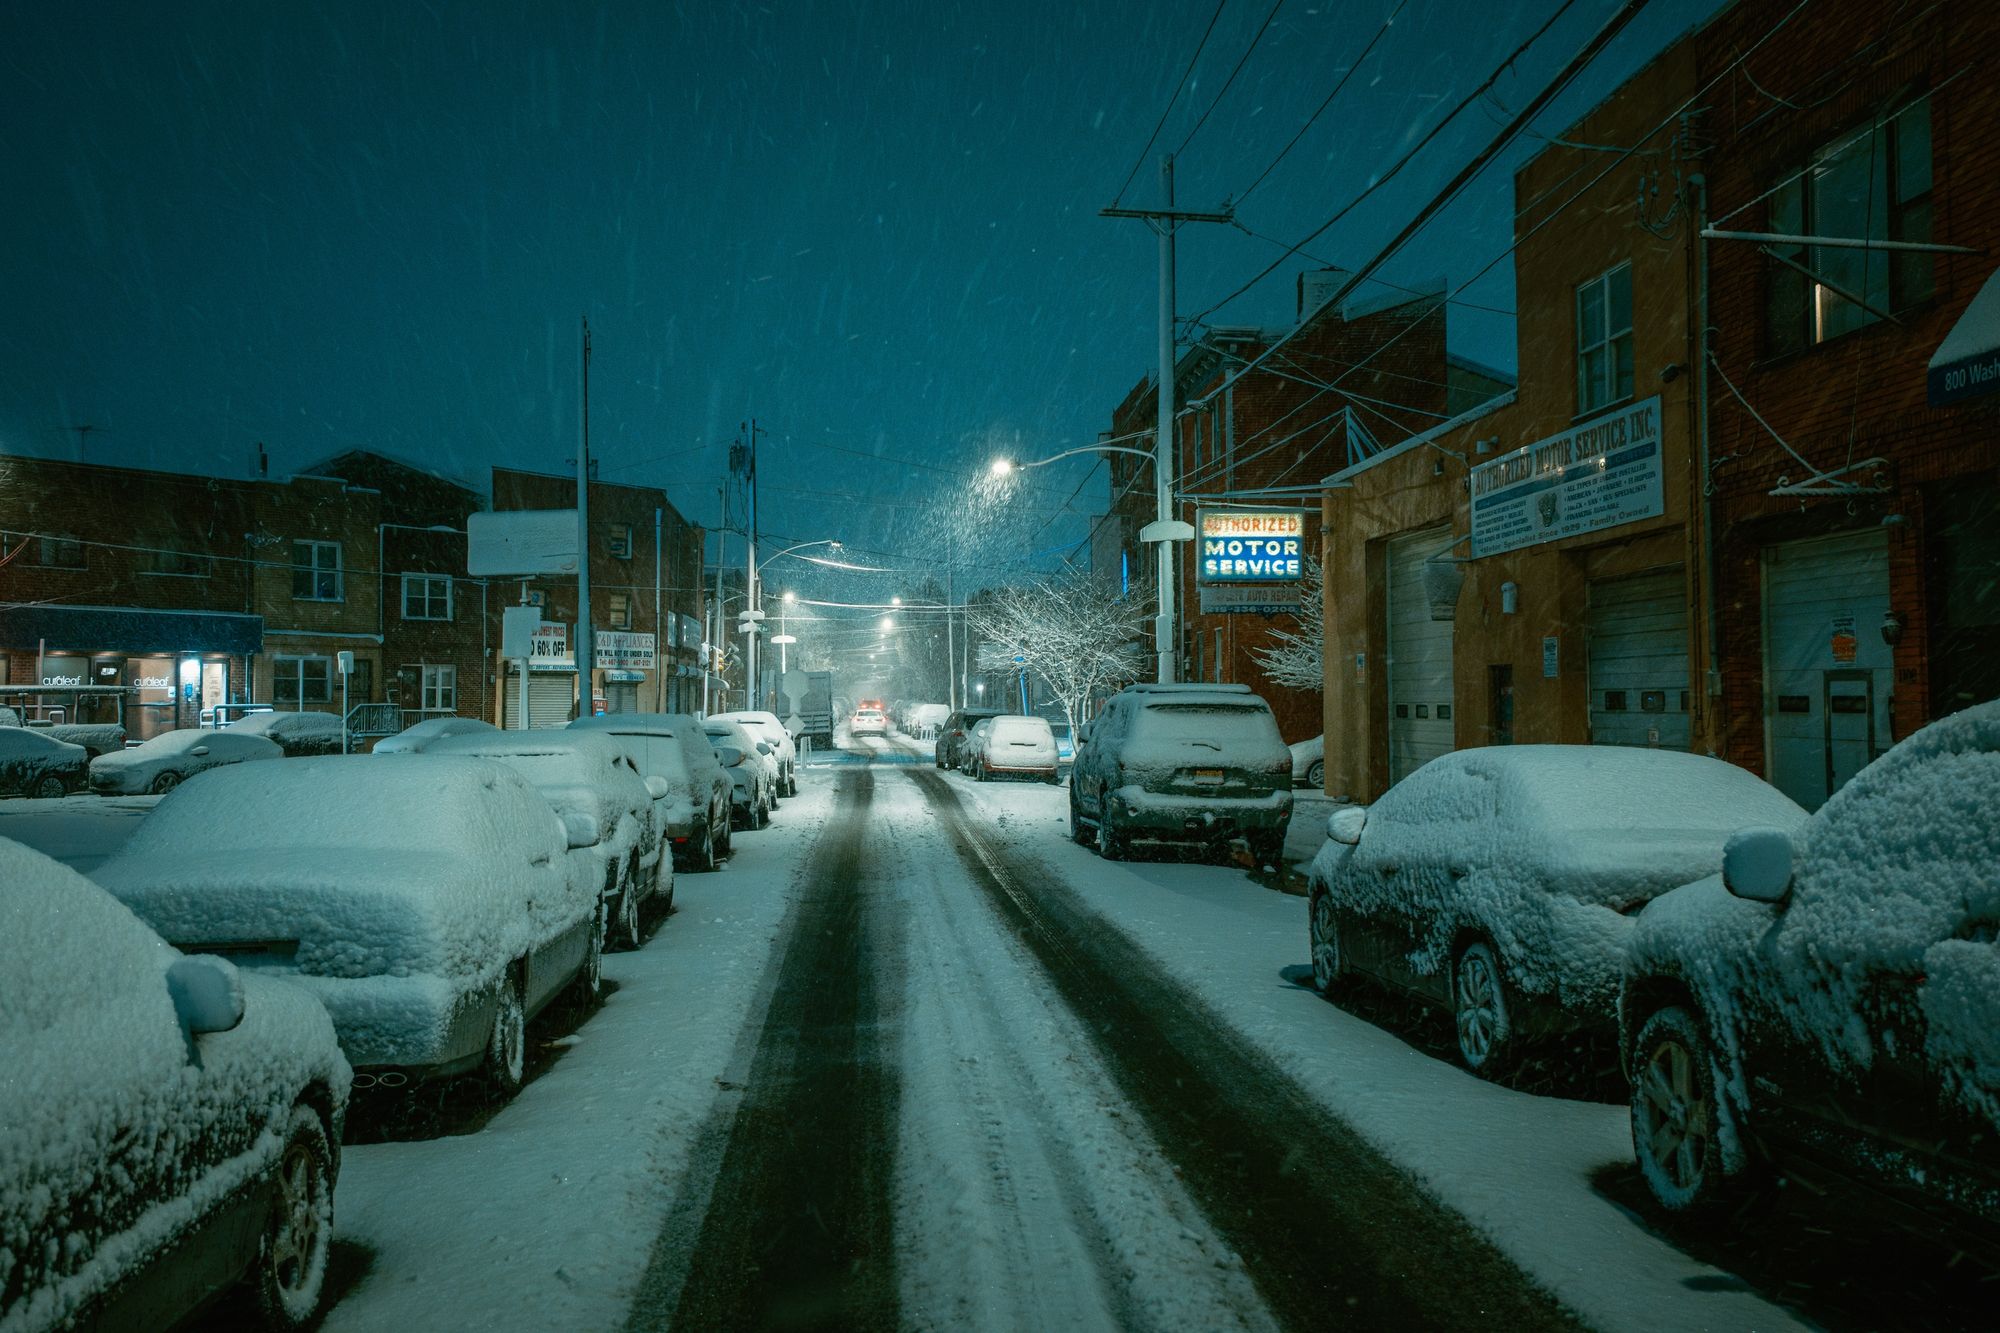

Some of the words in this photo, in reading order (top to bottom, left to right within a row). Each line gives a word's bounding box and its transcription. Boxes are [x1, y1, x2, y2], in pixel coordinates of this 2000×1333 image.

[1945, 368, 1966, 392] 800
[1475, 453, 1532, 496] AUTHORIZED
[1535, 438, 1572, 475] MOTOR
[1575, 417, 1627, 461] SERVICE
[1630, 406, 1656, 443] INC.
[1204, 517, 1298, 532] AUTHORIZED
[1504, 534, 1536, 548] Specialist
[1538, 529, 1558, 539] Since
[1589, 513, 1616, 528] Family
[1618, 504, 1649, 519] Owned
[1205, 540, 1298, 556] MOTOR
[1205, 559, 1299, 576] SERVICE
[1247, 590, 1268, 602] AUTO
[537, 639, 551, 657] 60%
[552, 640, 565, 657] OFF
[613, 634, 653, 649] APPLIANCES
[614, 650, 622, 658] NOT
[623, 650, 629, 658] BE
[630, 650, 642, 658] UNDER
[42, 675, 82, 687] curaleaf
[133, 675, 169, 688] curaleaf
